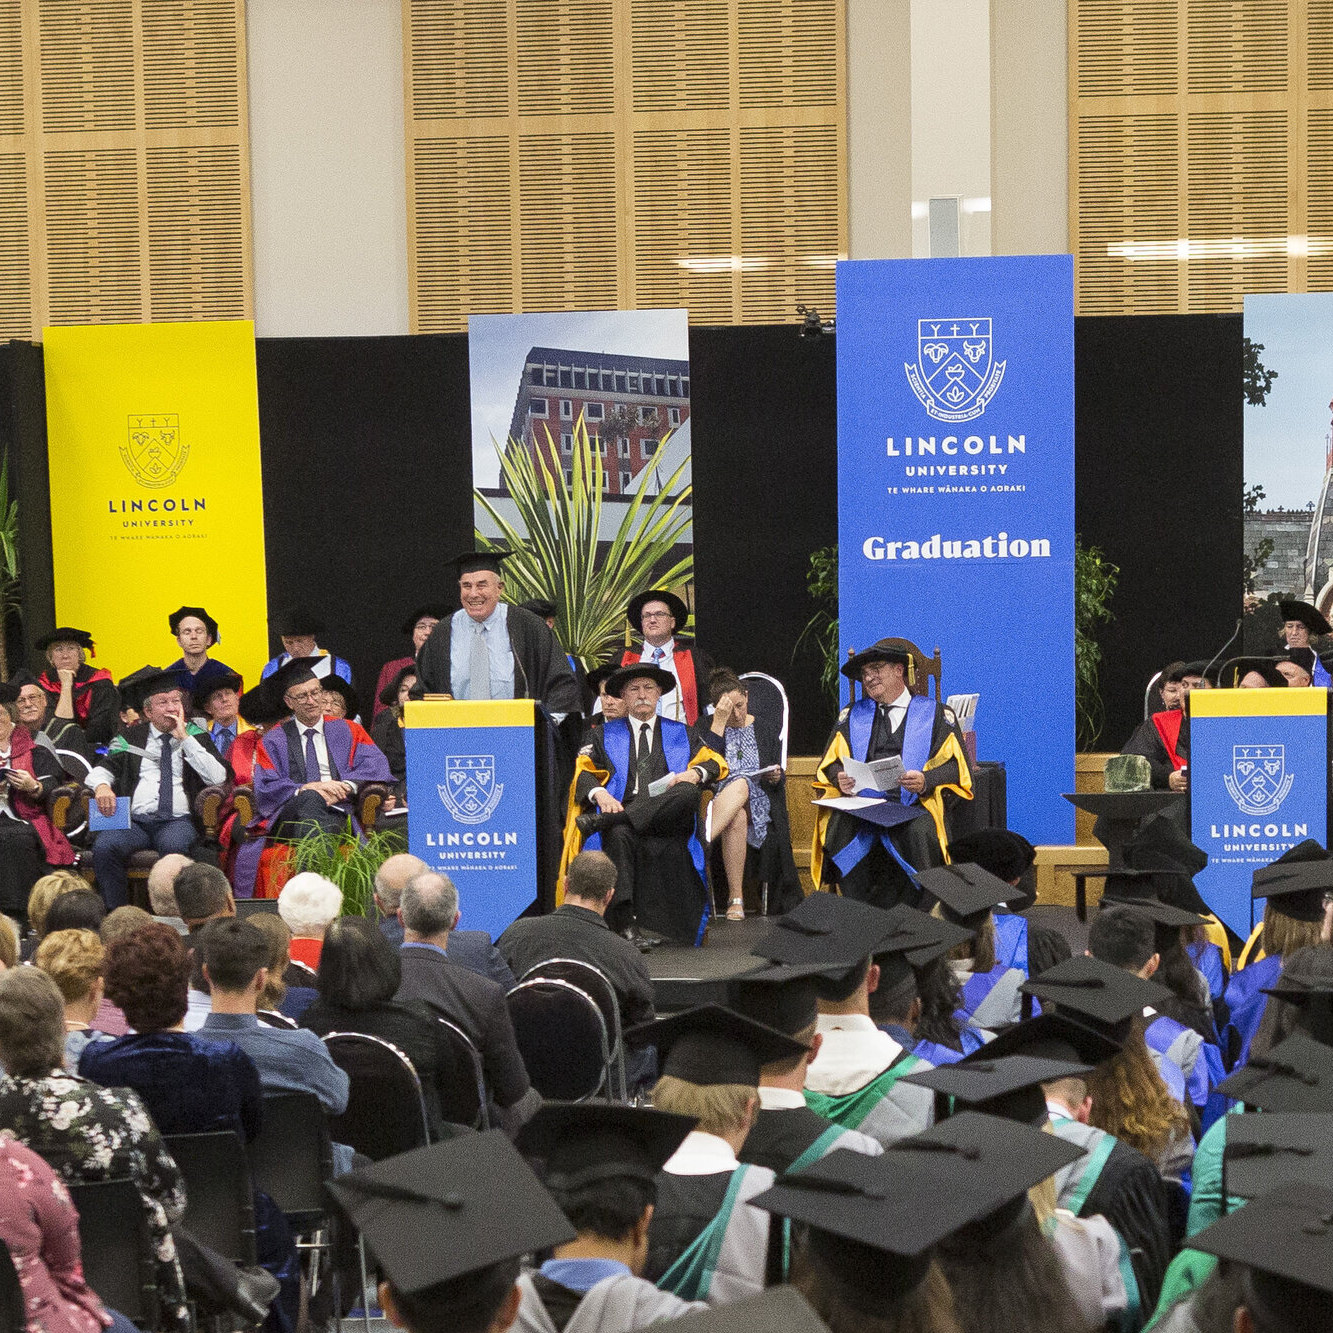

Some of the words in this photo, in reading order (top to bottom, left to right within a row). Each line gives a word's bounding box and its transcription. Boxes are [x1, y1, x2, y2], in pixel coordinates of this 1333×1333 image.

[886, 434, 1026, 456] LINCOLN
[905, 464, 1008, 476] UNIVERSITY
[108, 498, 206, 513] LINCOLN
[122, 519, 194, 528] UNIVERSITY
[862, 532, 1051, 560] Graduation
[1210, 823, 1308, 838] LINCOLN
[426, 832, 517, 846] LINCOLN
[1224, 843, 1294, 851] UNIVERSITY
[439, 851, 506, 859] UNIVERSITY
